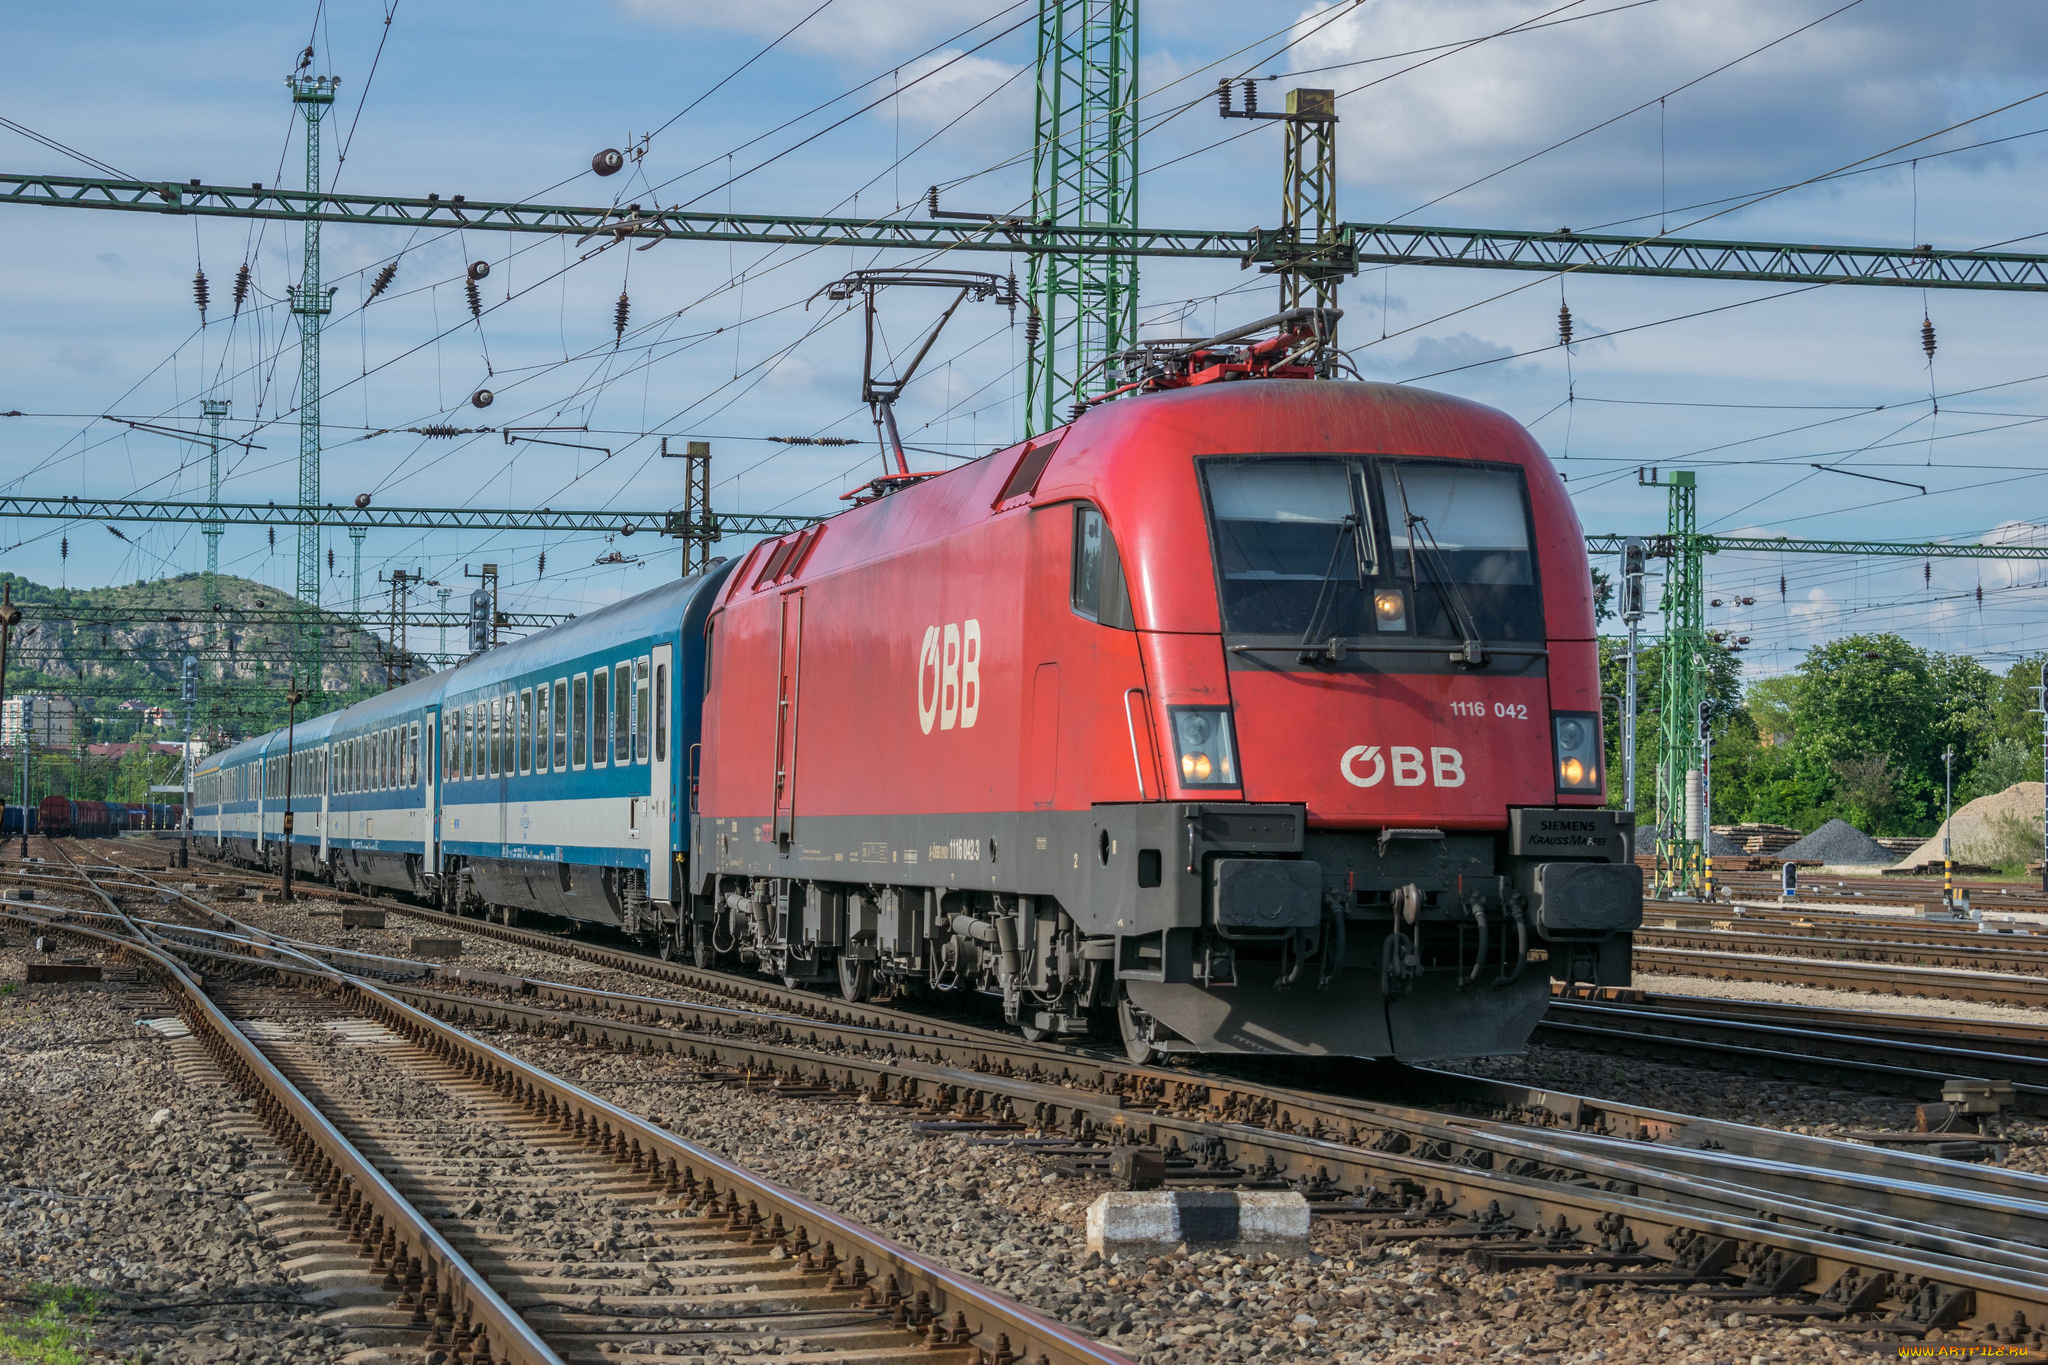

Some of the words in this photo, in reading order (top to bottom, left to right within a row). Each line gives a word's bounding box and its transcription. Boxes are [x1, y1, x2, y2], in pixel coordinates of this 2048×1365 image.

[918, 618, 981, 735] ÖBB
[1449, 701, 1486, 717] 1116
[1494, 702, 1529, 720] 042
[1340, 745, 1466, 787] ÖBB
[1540, 820, 1596, 832] SIEMENS
[1073, 852, 1079, 868] 2
